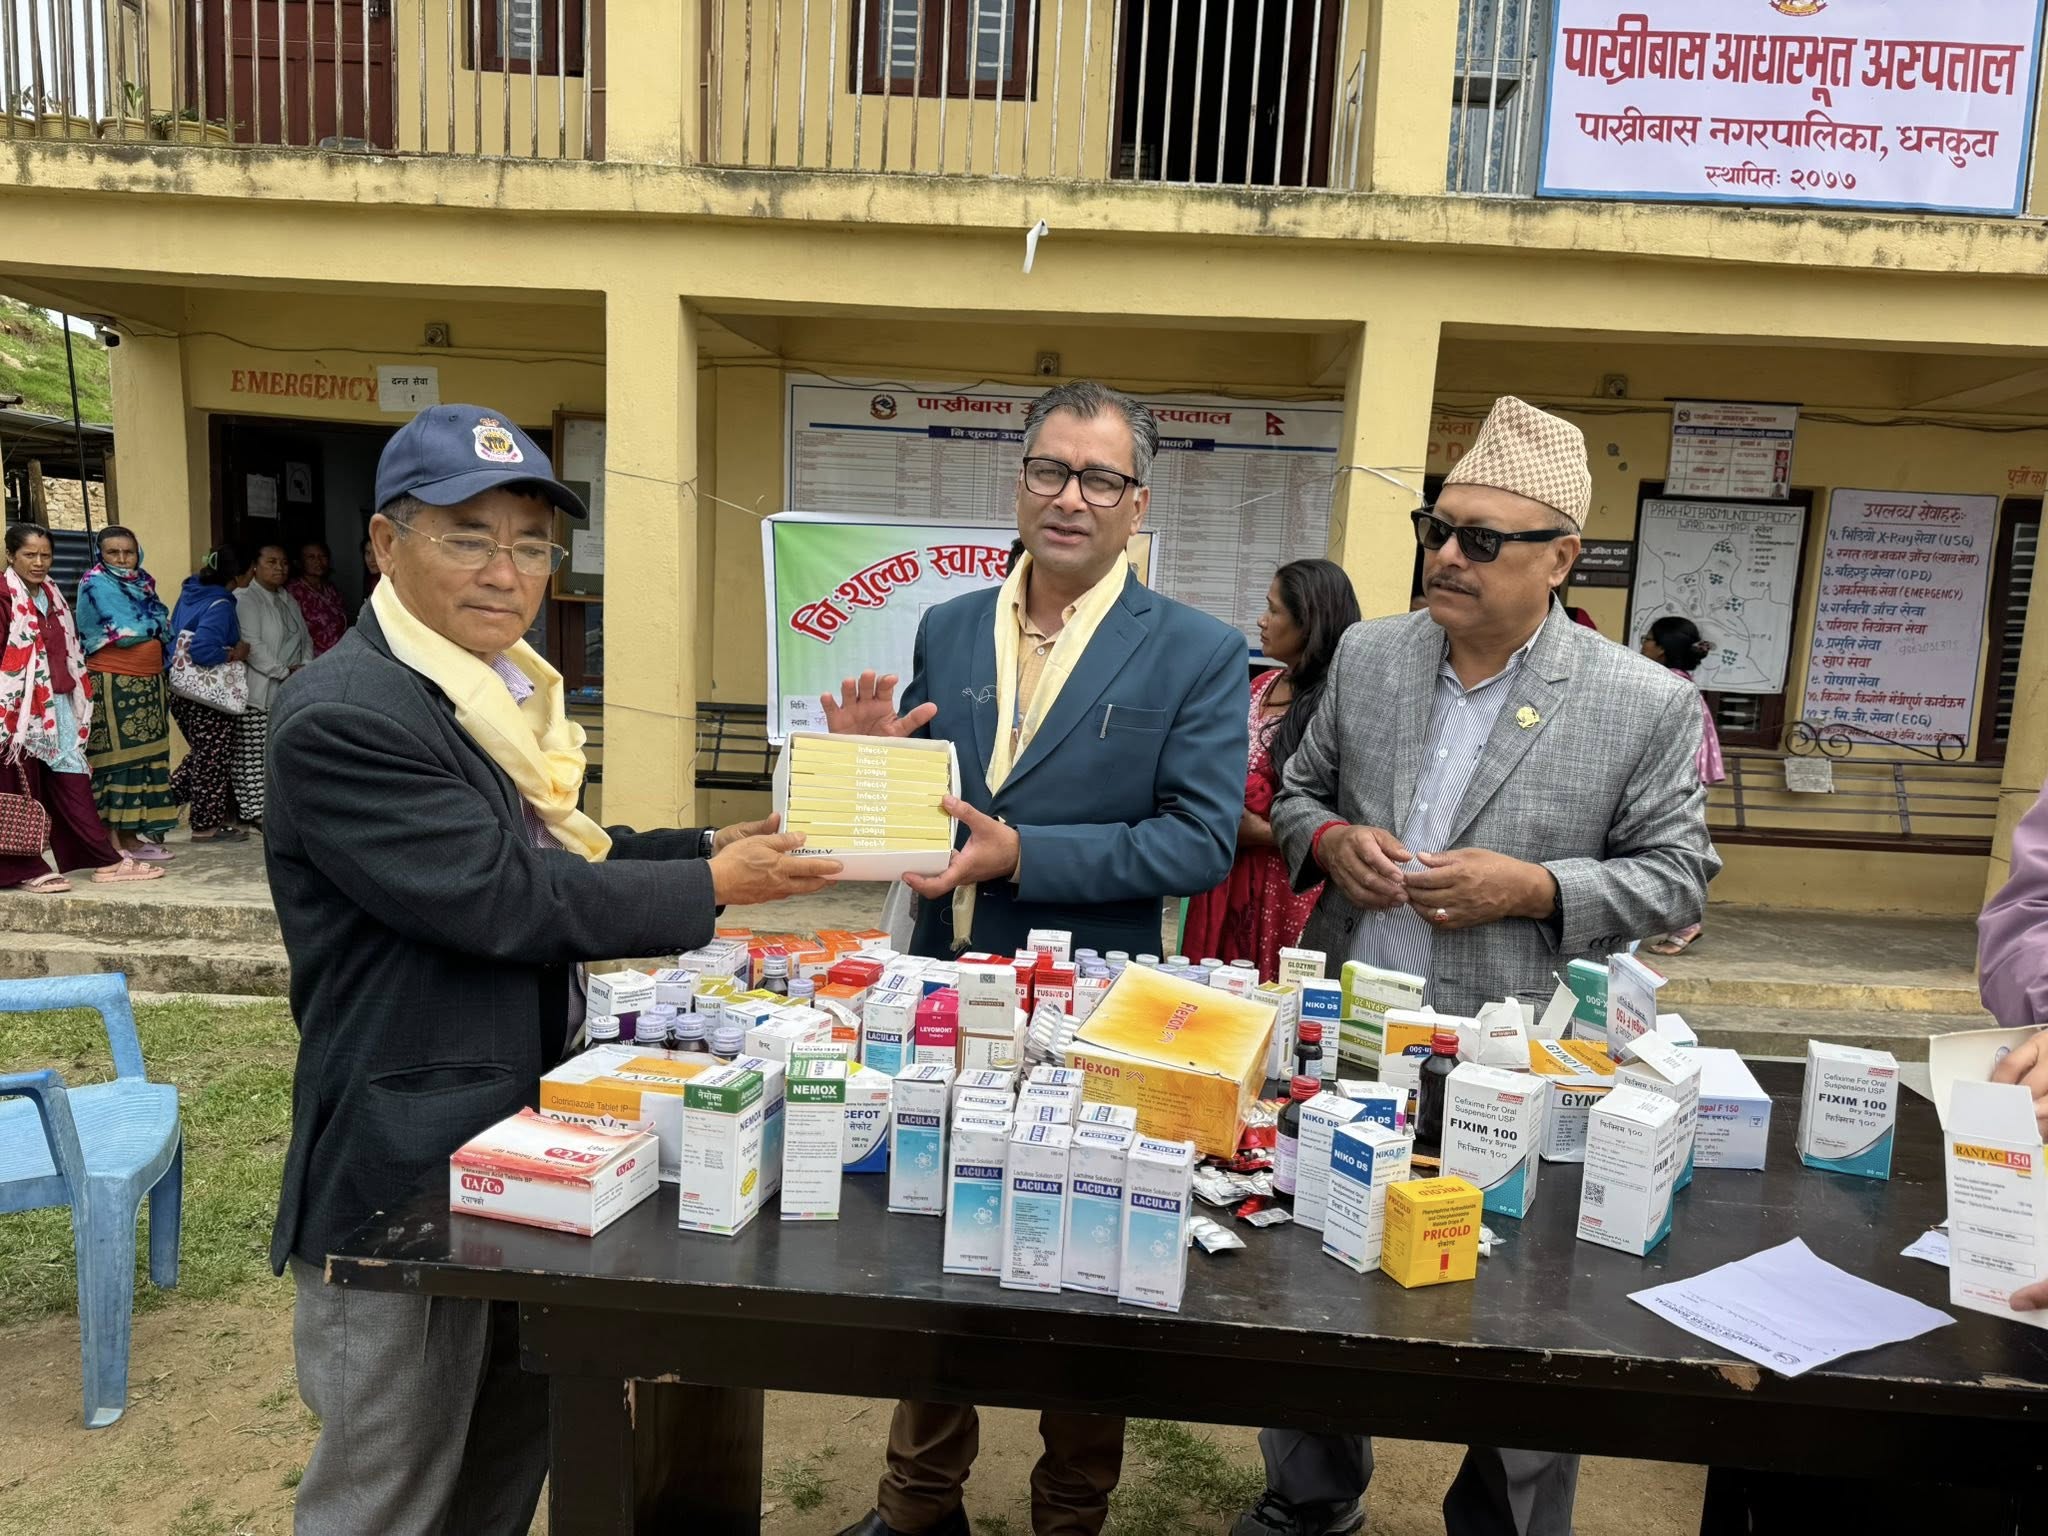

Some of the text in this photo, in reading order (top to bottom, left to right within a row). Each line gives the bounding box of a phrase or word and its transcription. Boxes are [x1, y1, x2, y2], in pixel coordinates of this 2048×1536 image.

[1563, 14, 2024, 107] पाख्रीबास आधारभूत अस्पताल
[1576, 106, 1998, 168] पाख्रीबास नगरपालिका, धनकुटा
[1790, 169, 1856, 190] २०७७
[231, 369, 377, 402] EMERGENCY
[413, 377, 428, 385] सेवा
[916, 396, 1011, 414] पाख्रीबास
[1150, 409, 1232, 424] स्पताल
[1897, 570, 1932, 582] (OPD)
[1900, 602, 1926, 618] सेवा
[1826, 618, 1859, 632] परिवार
[1905, 620, 1928, 635] सेवा
[1858, 636, 1881, 651] सेवा
[1848, 653, 1871, 668] सेवा
[1858, 673, 1880, 687] सेवा
[1870, 708, 1894, 724] सेवा
[1895, 713, 1932, 727] (ECG)
[859, 746, 888, 755] Infect-V
[856, 758, 886, 766] Infect-V
[856, 780, 887, 788] Infect-V
[1037, 990, 1069, 998] TUSSIVE-D
[1165, 1002, 1199, 1031] Flexon
[868, 1033, 900, 1042] LACULAX
[1074, 1056, 1121, 1078] Flexon
[1824, 1072, 1887, 1088] Cefixime For Oral
[793, 1085, 837, 1094] NEMOX
[1649, 1083, 1663, 1093] १००
[1824, 1081, 1885, 1095] Suspension USP
[551, 1095, 628, 1113] Clotrimazole Tablet IP
[1454, 1096, 1517, 1115] Cefixime For Oral
[1819, 1093, 1887, 1111] FIXIM 100
[740, 1109, 761, 1131] NEMOX
[1302, 1113, 1339, 1128] NIKO DS
[1378, 1116, 1391, 1124] DS
[1455, 1104, 1515, 1122] Suspension USP
[1864, 1110, 1886, 1119] Syrup
[900, 1116, 937, 1126] LACULAX
[1858, 1119, 1876, 1128] १००
[1450, 1118, 1518, 1141] FIXIM 100
[1628, 1129, 1643, 1138] १००
[1480, 1136, 1517, 1149] Dry Syrup
[1334, 1149, 1368, 1172] NIKO DS
[1376, 1149, 1395, 1159] NIKO
[1490, 1149, 1508, 1159] १००
[1955, 1144, 2030, 1167] RANTAC 150
[957, 1167, 999, 1177] LACULAX
[1016, 1180, 1059, 1192] LACULAX
[1076, 1182, 1119, 1196] LACULAX
[1419, 1187, 1465, 1195] PRICOLD
[1134, 1195, 1177, 1211] LACULAX
[1388, 1195, 1411, 1214] PRICOLD
[1424, 1225, 1471, 1240] PRICOLD
